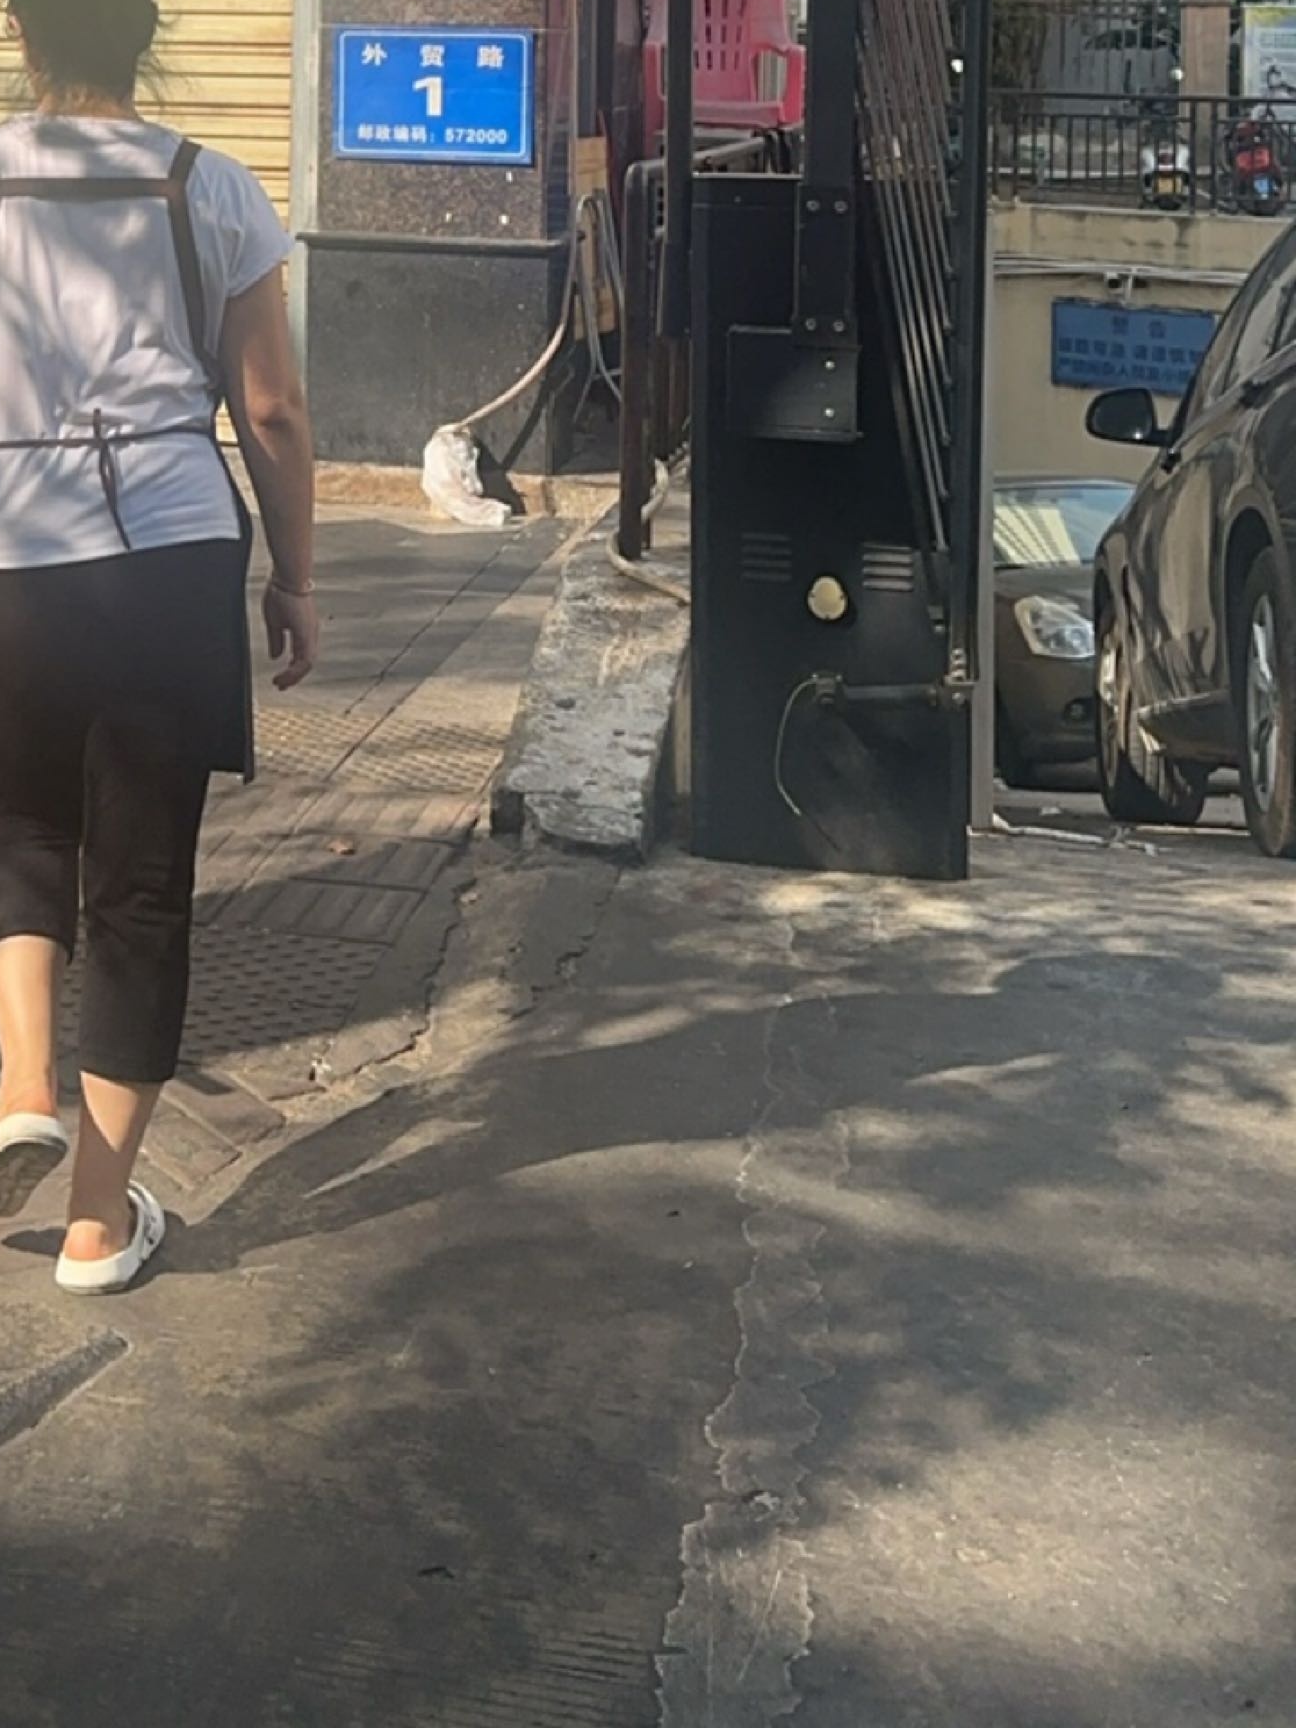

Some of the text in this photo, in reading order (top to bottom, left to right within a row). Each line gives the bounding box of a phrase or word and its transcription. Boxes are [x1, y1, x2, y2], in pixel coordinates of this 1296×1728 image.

[360, 42, 505, 69] 外贸路
[412, 75, 443, 117] 1
